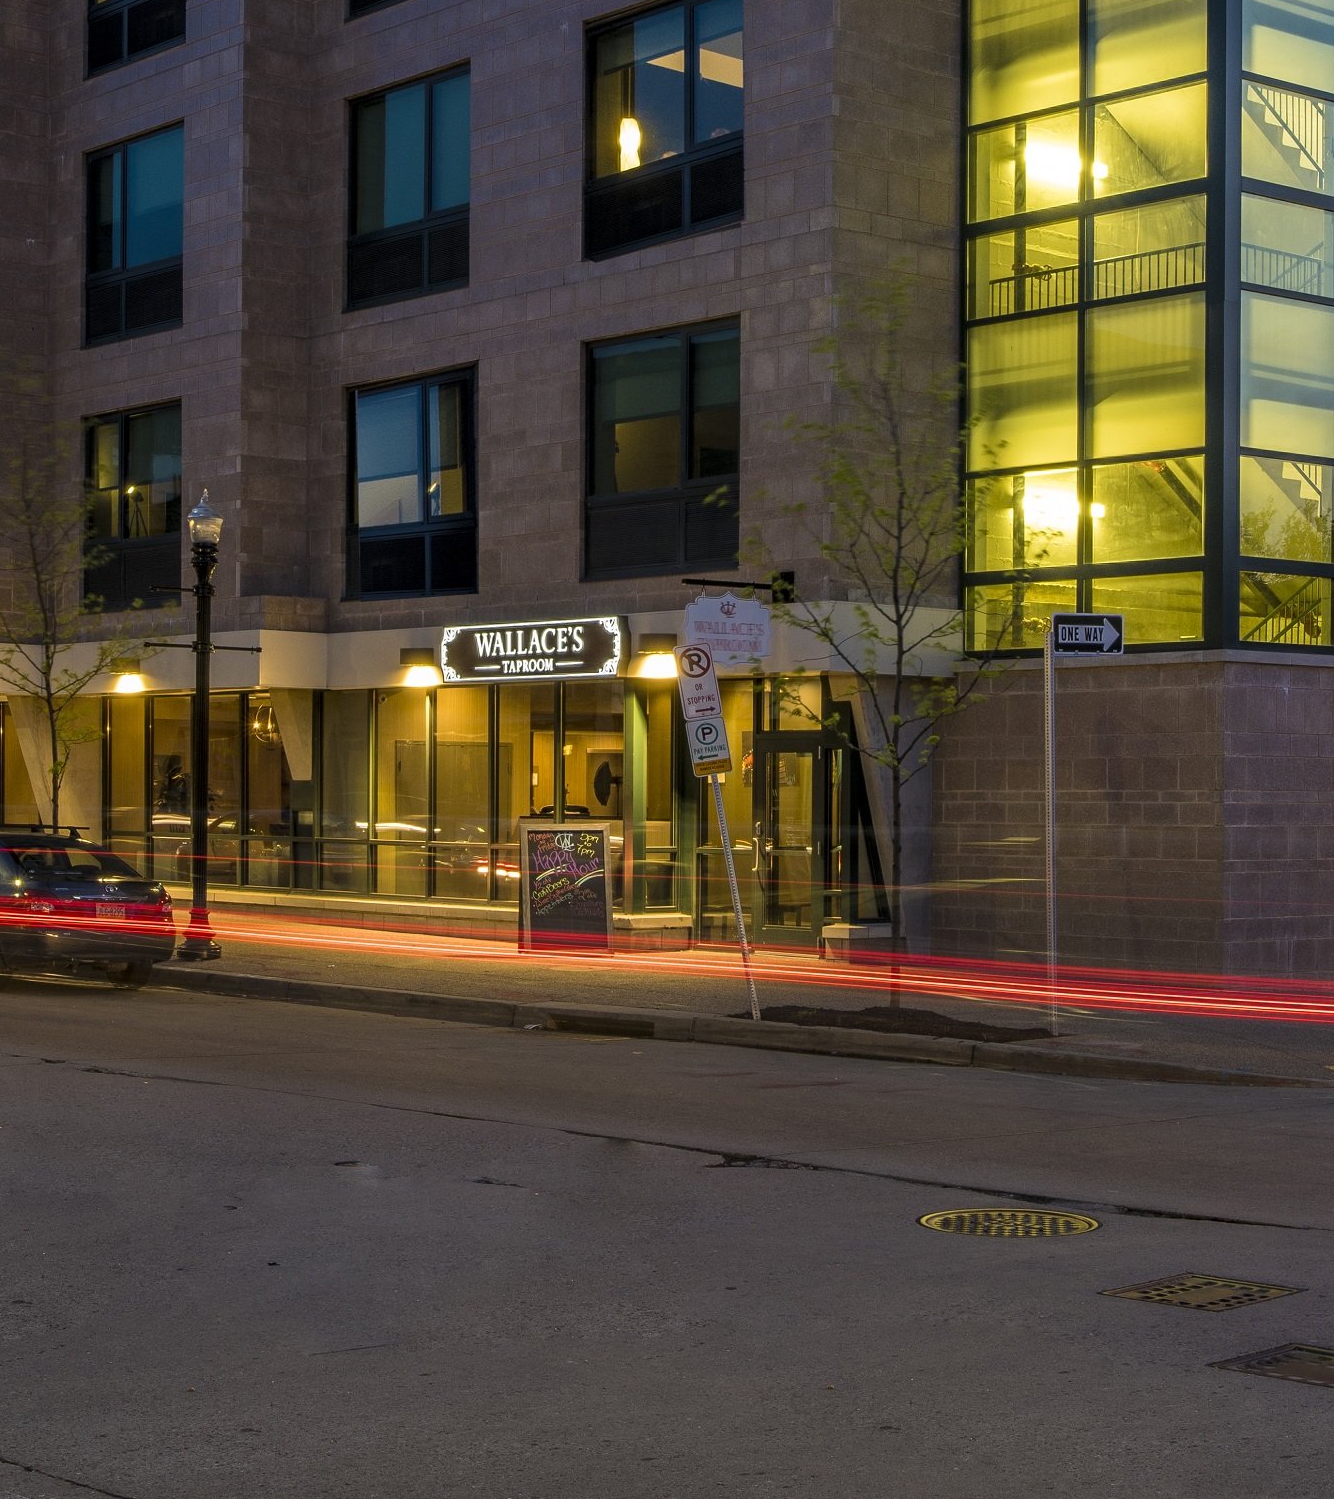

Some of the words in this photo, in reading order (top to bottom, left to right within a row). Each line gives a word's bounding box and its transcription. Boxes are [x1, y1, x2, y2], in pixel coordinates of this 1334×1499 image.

[1061, 626, 1080, 641] ONE
[1084, 627, 1104, 642] WAY
[474, 626, 584, 658] WALLACE'S
[502, 659, 554, 673] TAPROOM
[695, 683, 704, 691] OR
[687, 694, 716, 706] STOPPING
[693, 748, 704, 756] PAY
[704, 744, 727, 754] PARKING
[532, 850, 576, 877] Happy
[566, 857, 600, 880] Hour
